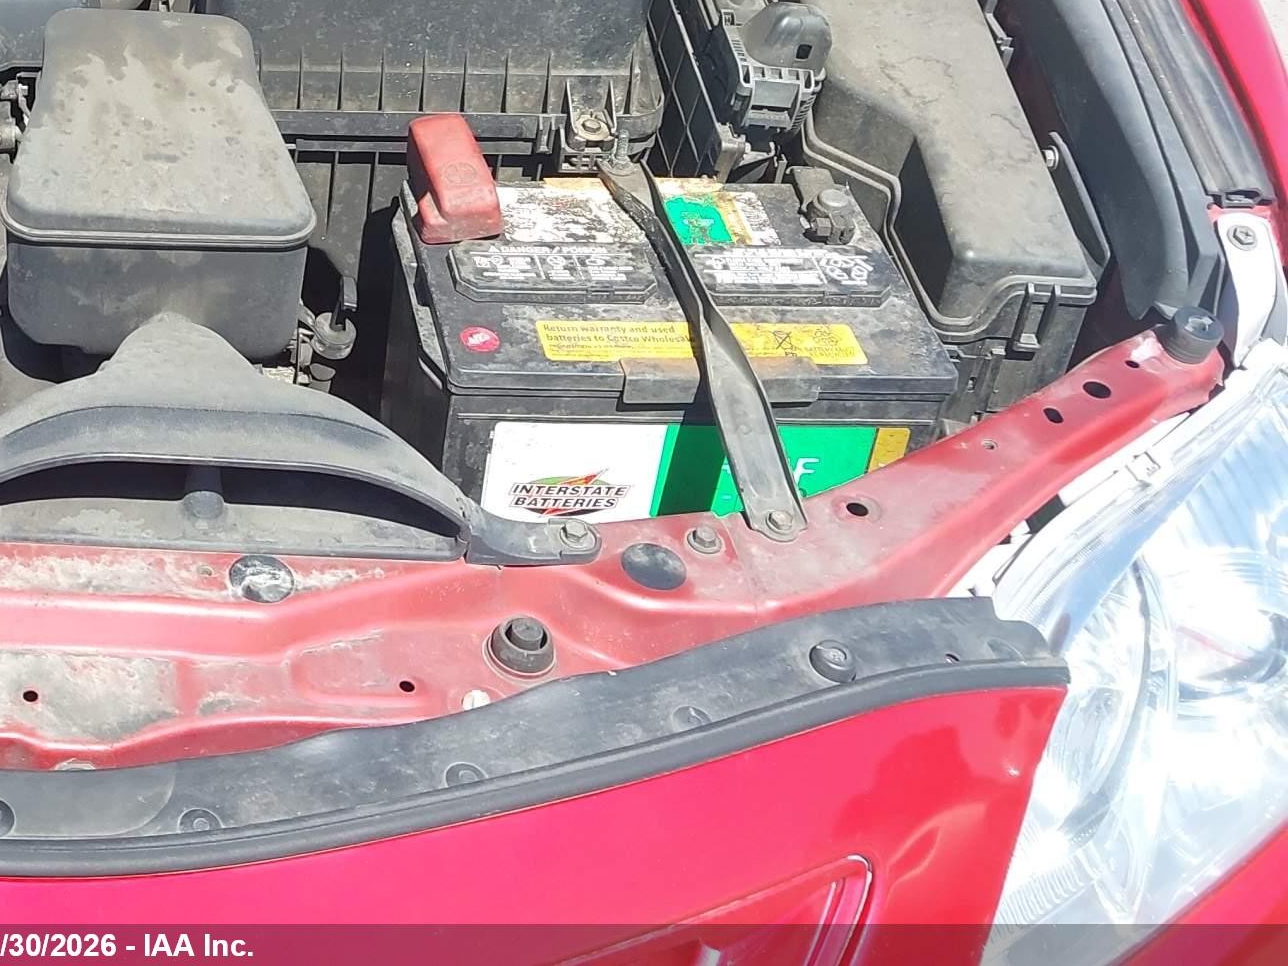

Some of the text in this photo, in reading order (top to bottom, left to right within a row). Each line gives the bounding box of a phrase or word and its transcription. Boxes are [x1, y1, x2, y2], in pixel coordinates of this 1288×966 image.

[543, 324, 675, 334] Return warranty and used
[545, 334, 592, 342] batteries
[606, 334, 641, 343] Costco
[641, 335, 692, 343] Wholesal
[512, 484, 628, 496] INTERSTATE
[514, 497, 616, 508] BATTERIES
